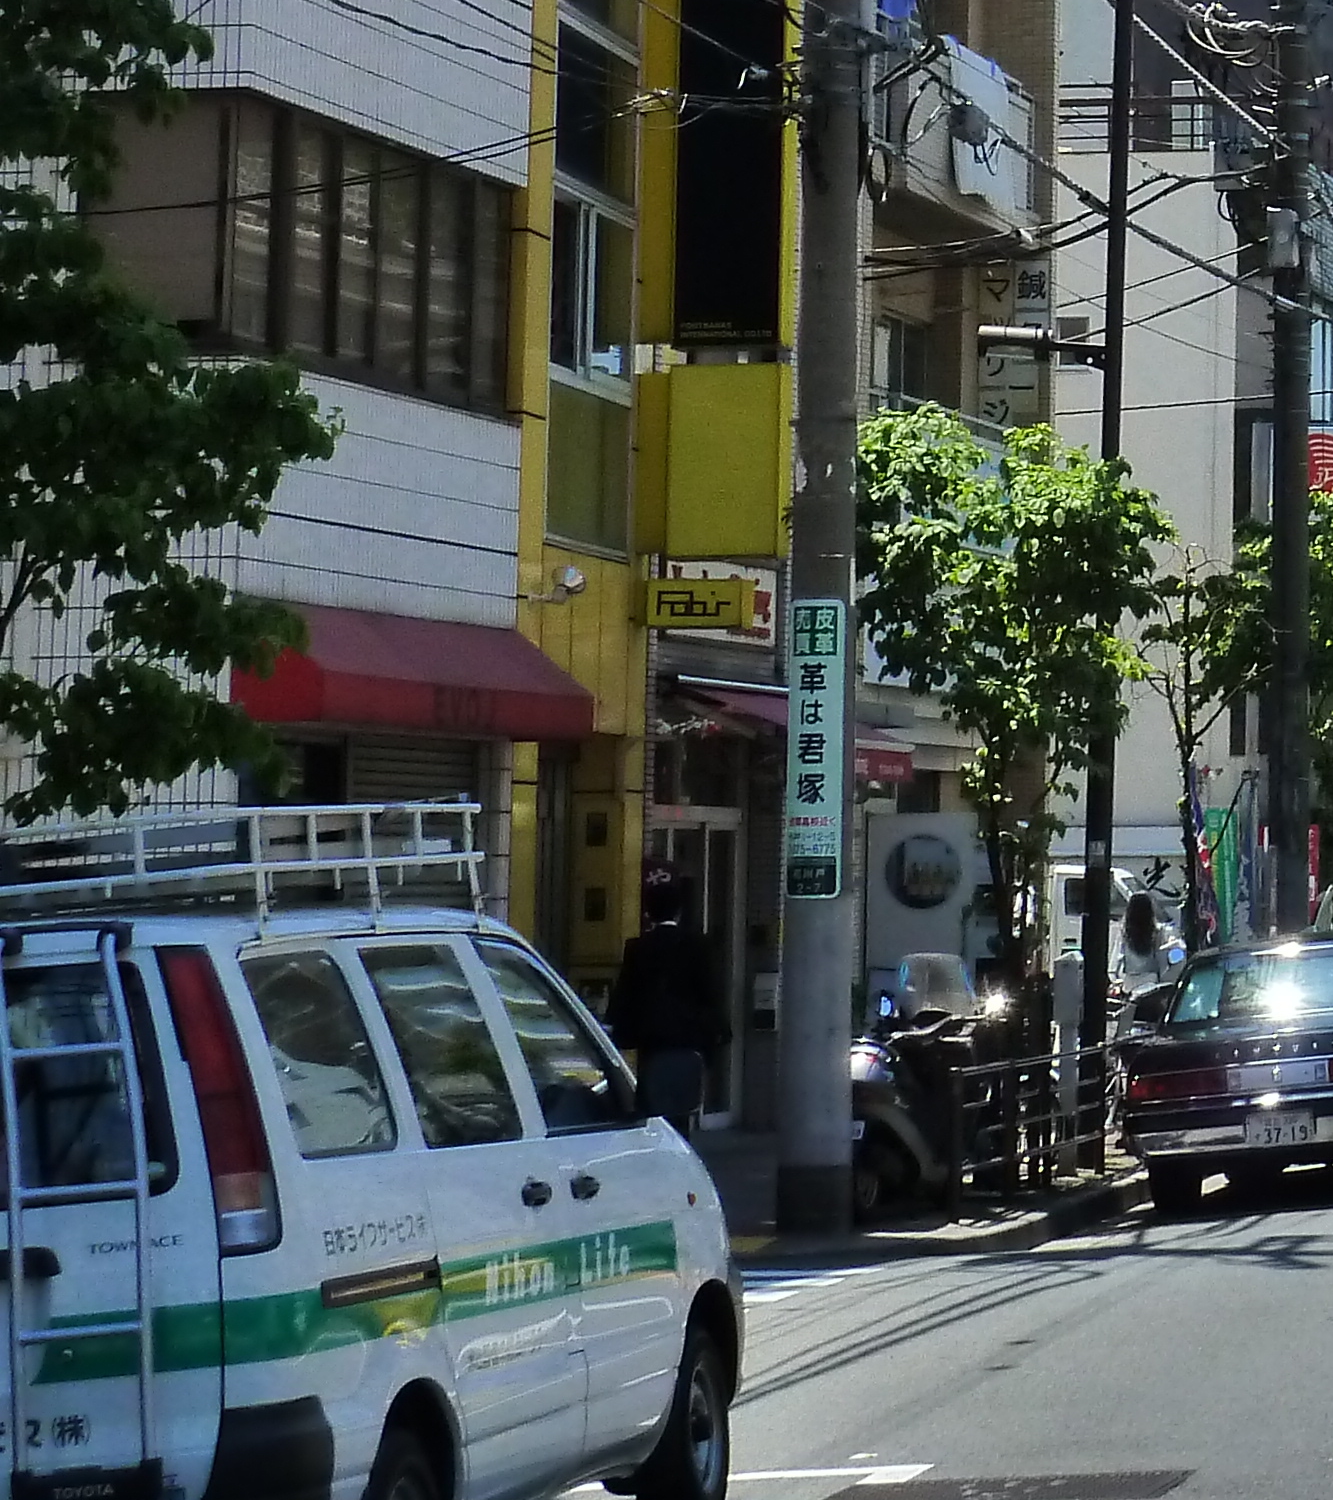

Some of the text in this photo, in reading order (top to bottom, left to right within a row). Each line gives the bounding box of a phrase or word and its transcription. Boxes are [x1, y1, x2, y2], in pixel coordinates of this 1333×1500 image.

[797, 661, 828, 805] 革は君塚
[796, 882, 821, 894] 2-7
[1264, 1125, 1308, 1144] 37-19
[485, 1231, 630, 1307] Nihon Life
[53, 1483, 114, 1500] TOYOTA
